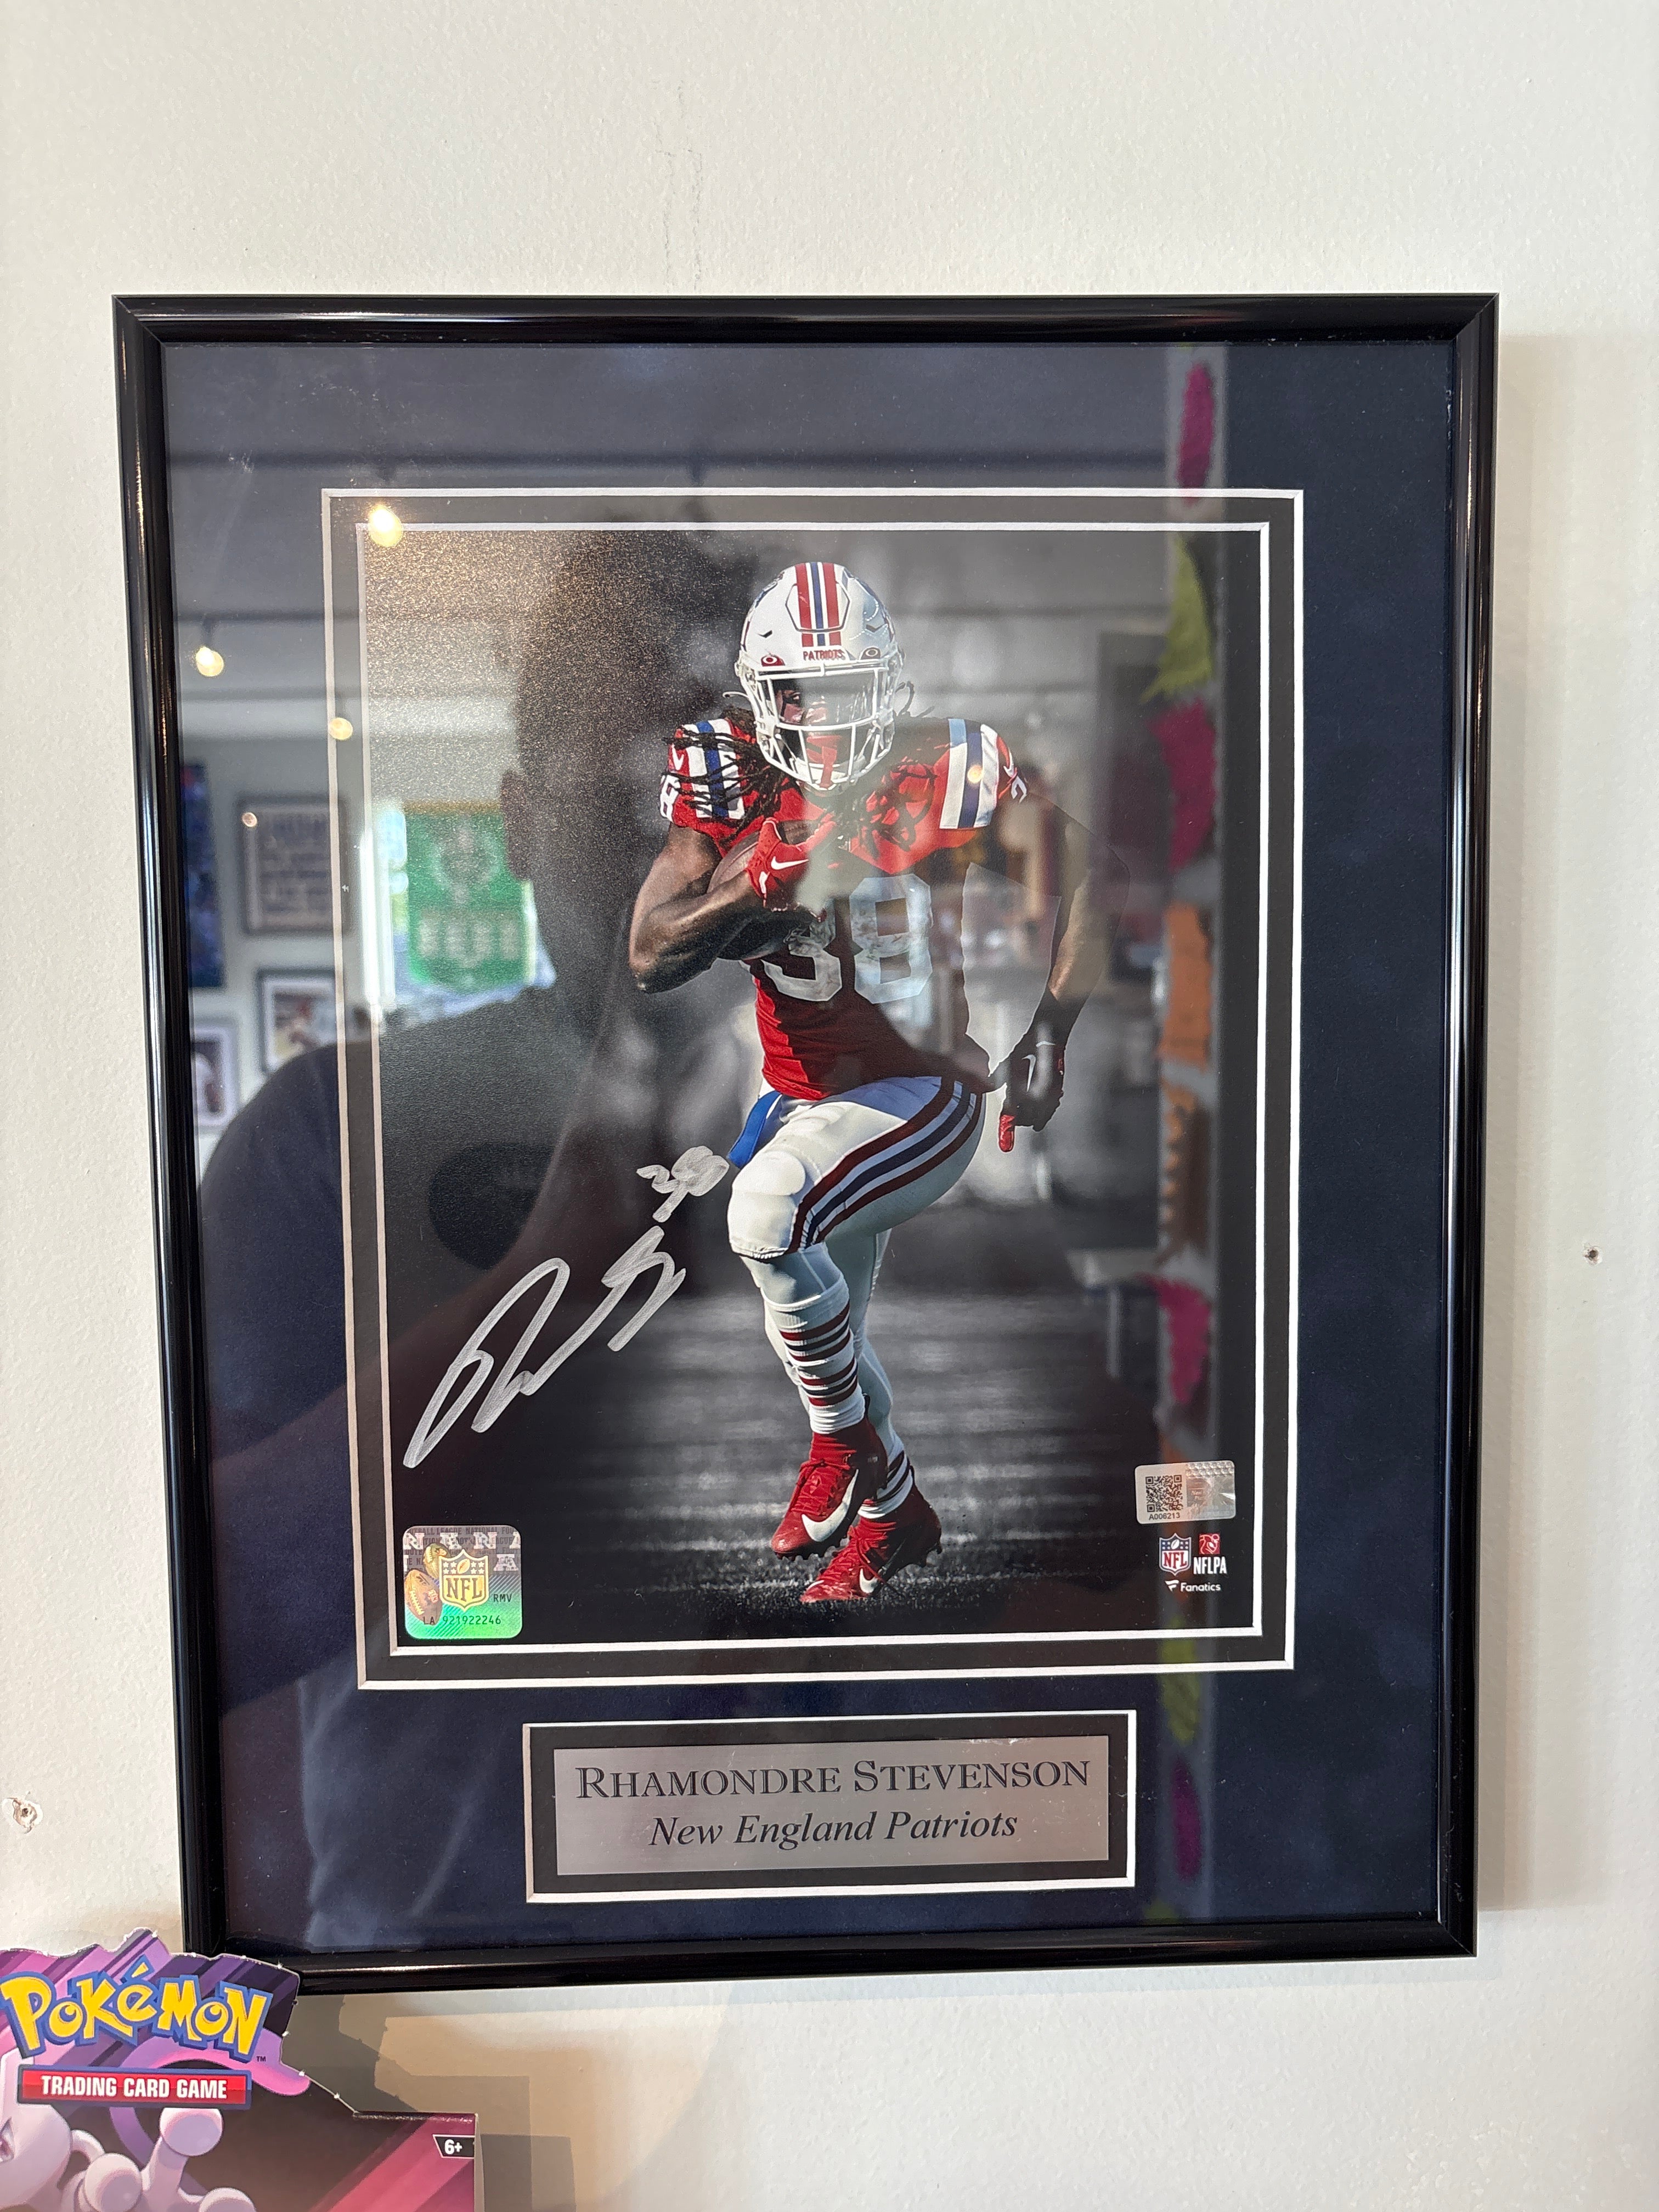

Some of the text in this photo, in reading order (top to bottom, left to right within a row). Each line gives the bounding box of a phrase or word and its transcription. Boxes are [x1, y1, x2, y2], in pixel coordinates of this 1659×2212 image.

[803, 649, 846, 661] PATRIOTS
[1149, 1513, 1181, 1521] A006213
[1164, 1552, 1188, 1570] NFL
[1193, 1556, 1227, 1575] NFLPA
[445, 1577, 483, 1602] NFL
[1180, 1582, 1221, 1592] Fanatics
[493, 1593, 513, 1602] RMV
[423, 1615, 501, 1625] LA 921922246
[648, 1810, 1018, 1851] New England Patriots
[41, 2075, 228, 2100] TRADING CARD GAME
[444, 2139, 463, 2155] 6+
